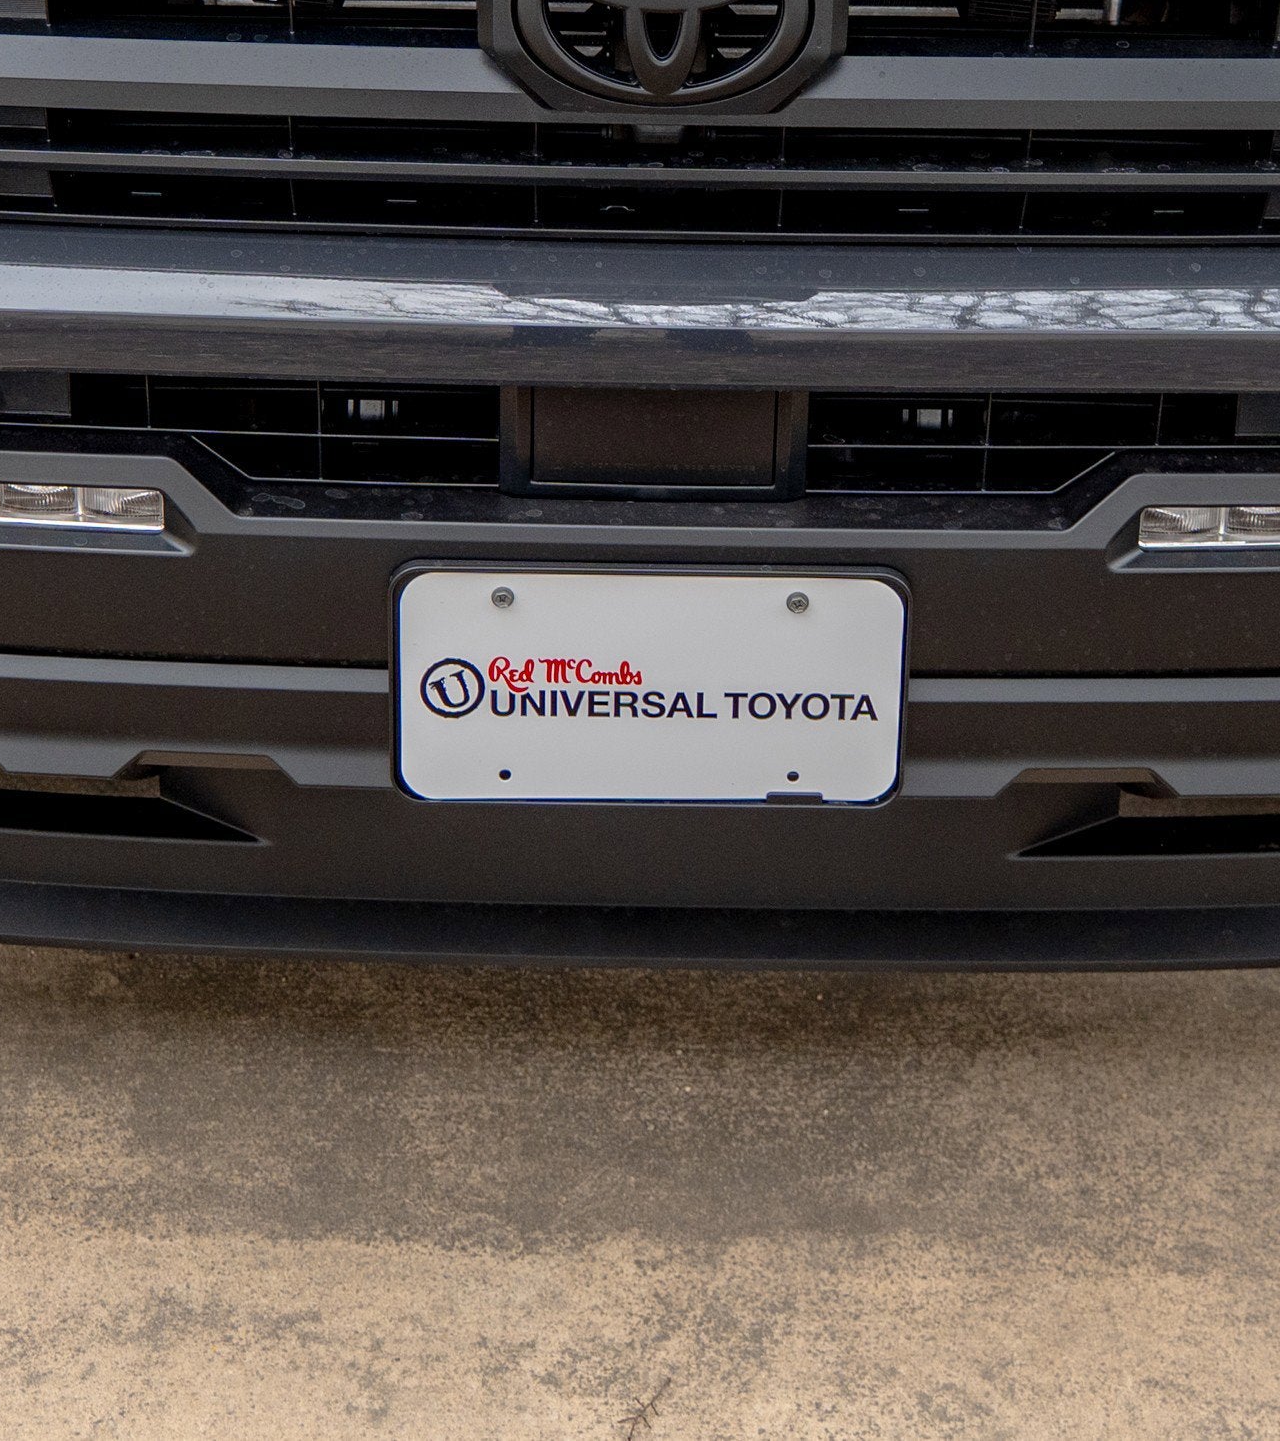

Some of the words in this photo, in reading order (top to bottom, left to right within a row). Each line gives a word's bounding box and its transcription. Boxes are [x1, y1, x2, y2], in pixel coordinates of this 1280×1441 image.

[488, 656, 535, 694] Red
[537, 657, 643, 686] McCombs
[490, 688, 718, 719] UNIVERSAL
[723, 691, 879, 721] TOYOTA
